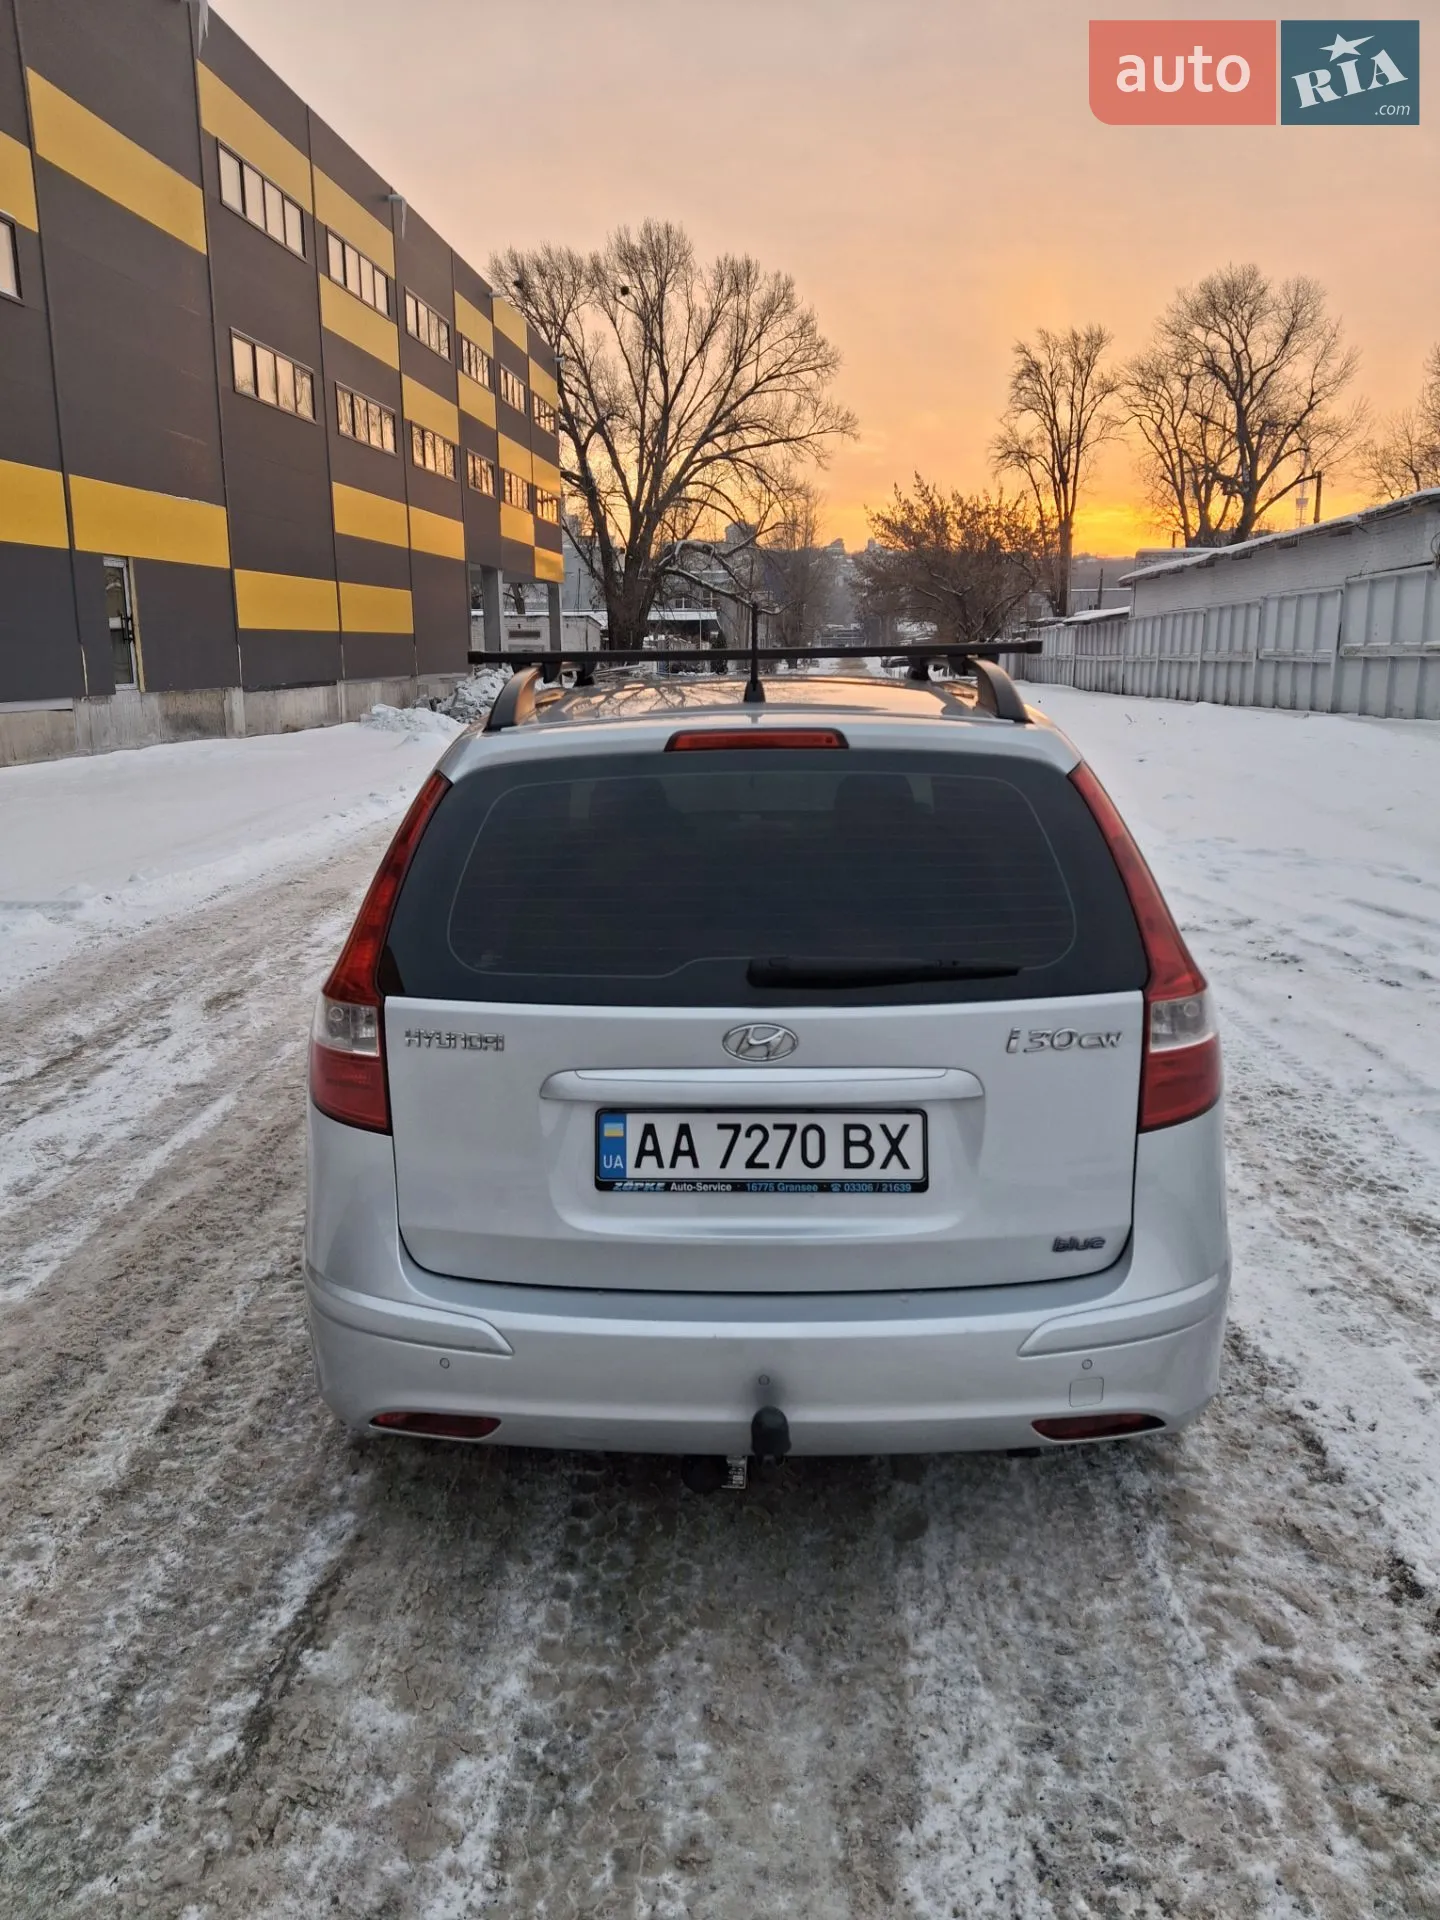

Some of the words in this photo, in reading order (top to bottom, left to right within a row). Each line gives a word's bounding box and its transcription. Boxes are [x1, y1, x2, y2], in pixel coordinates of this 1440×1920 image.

[404, 1029, 505, 1051] HYUNDAI
[634, 1123, 699, 1169] AA
[717, 1123, 826, 1169] 7270
[843, 1123, 911, 1170] BX
[603, 1155, 624, 1169] UA
[670, 1182, 732, 1192] Auto-Service
[746, 1183, 775, 1192] 16775
[777, 1183, 818, 1192] Gransee
[882, 1183, 911, 1192] 21639
[1052, 1236, 1106, 1252] blue
